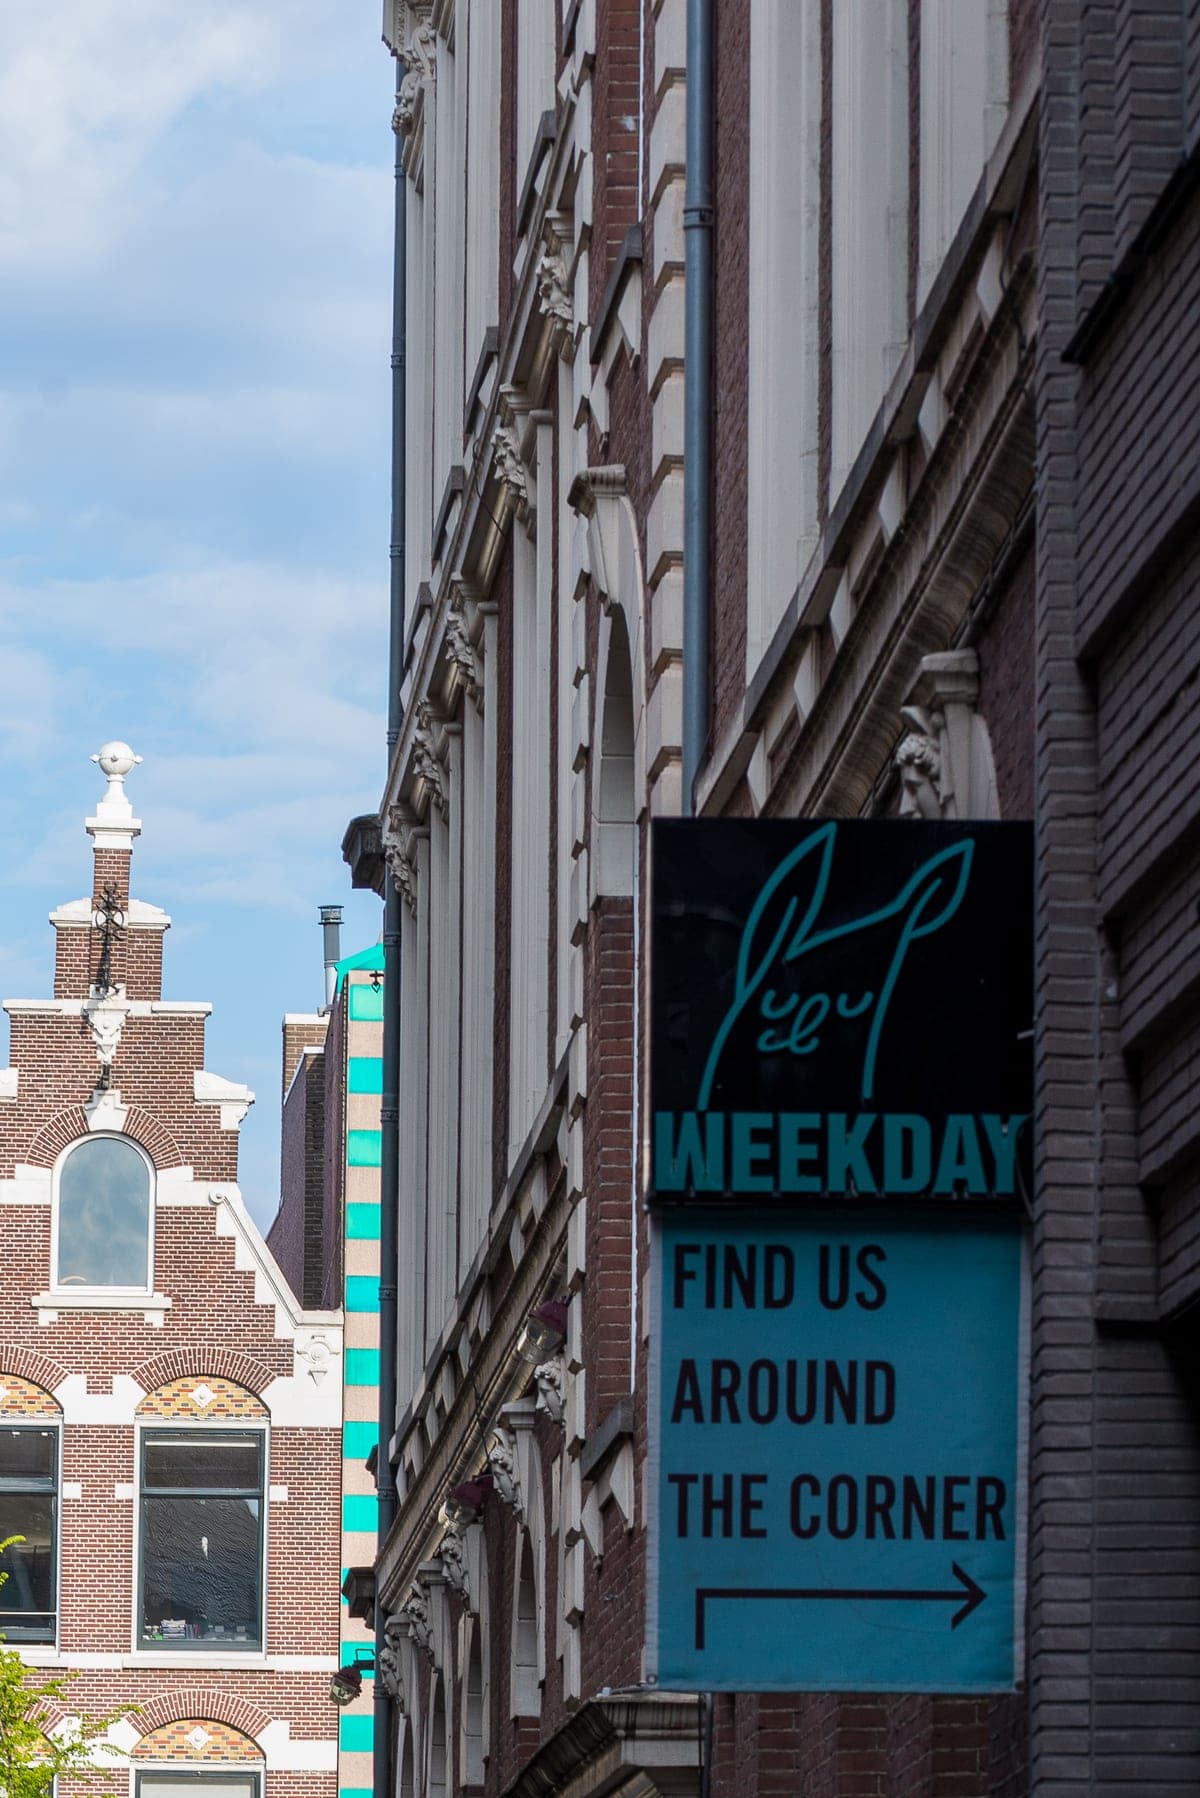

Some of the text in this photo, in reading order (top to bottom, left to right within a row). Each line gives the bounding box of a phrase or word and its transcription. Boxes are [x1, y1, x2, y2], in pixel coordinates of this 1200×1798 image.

[654, 1111, 1030, 1194] WEEKDAY
[672, 1243, 889, 1311] FIND US
[670, 1357, 897, 1426] AROUND
[667, 1472, 1007, 1541] THE CORNER
